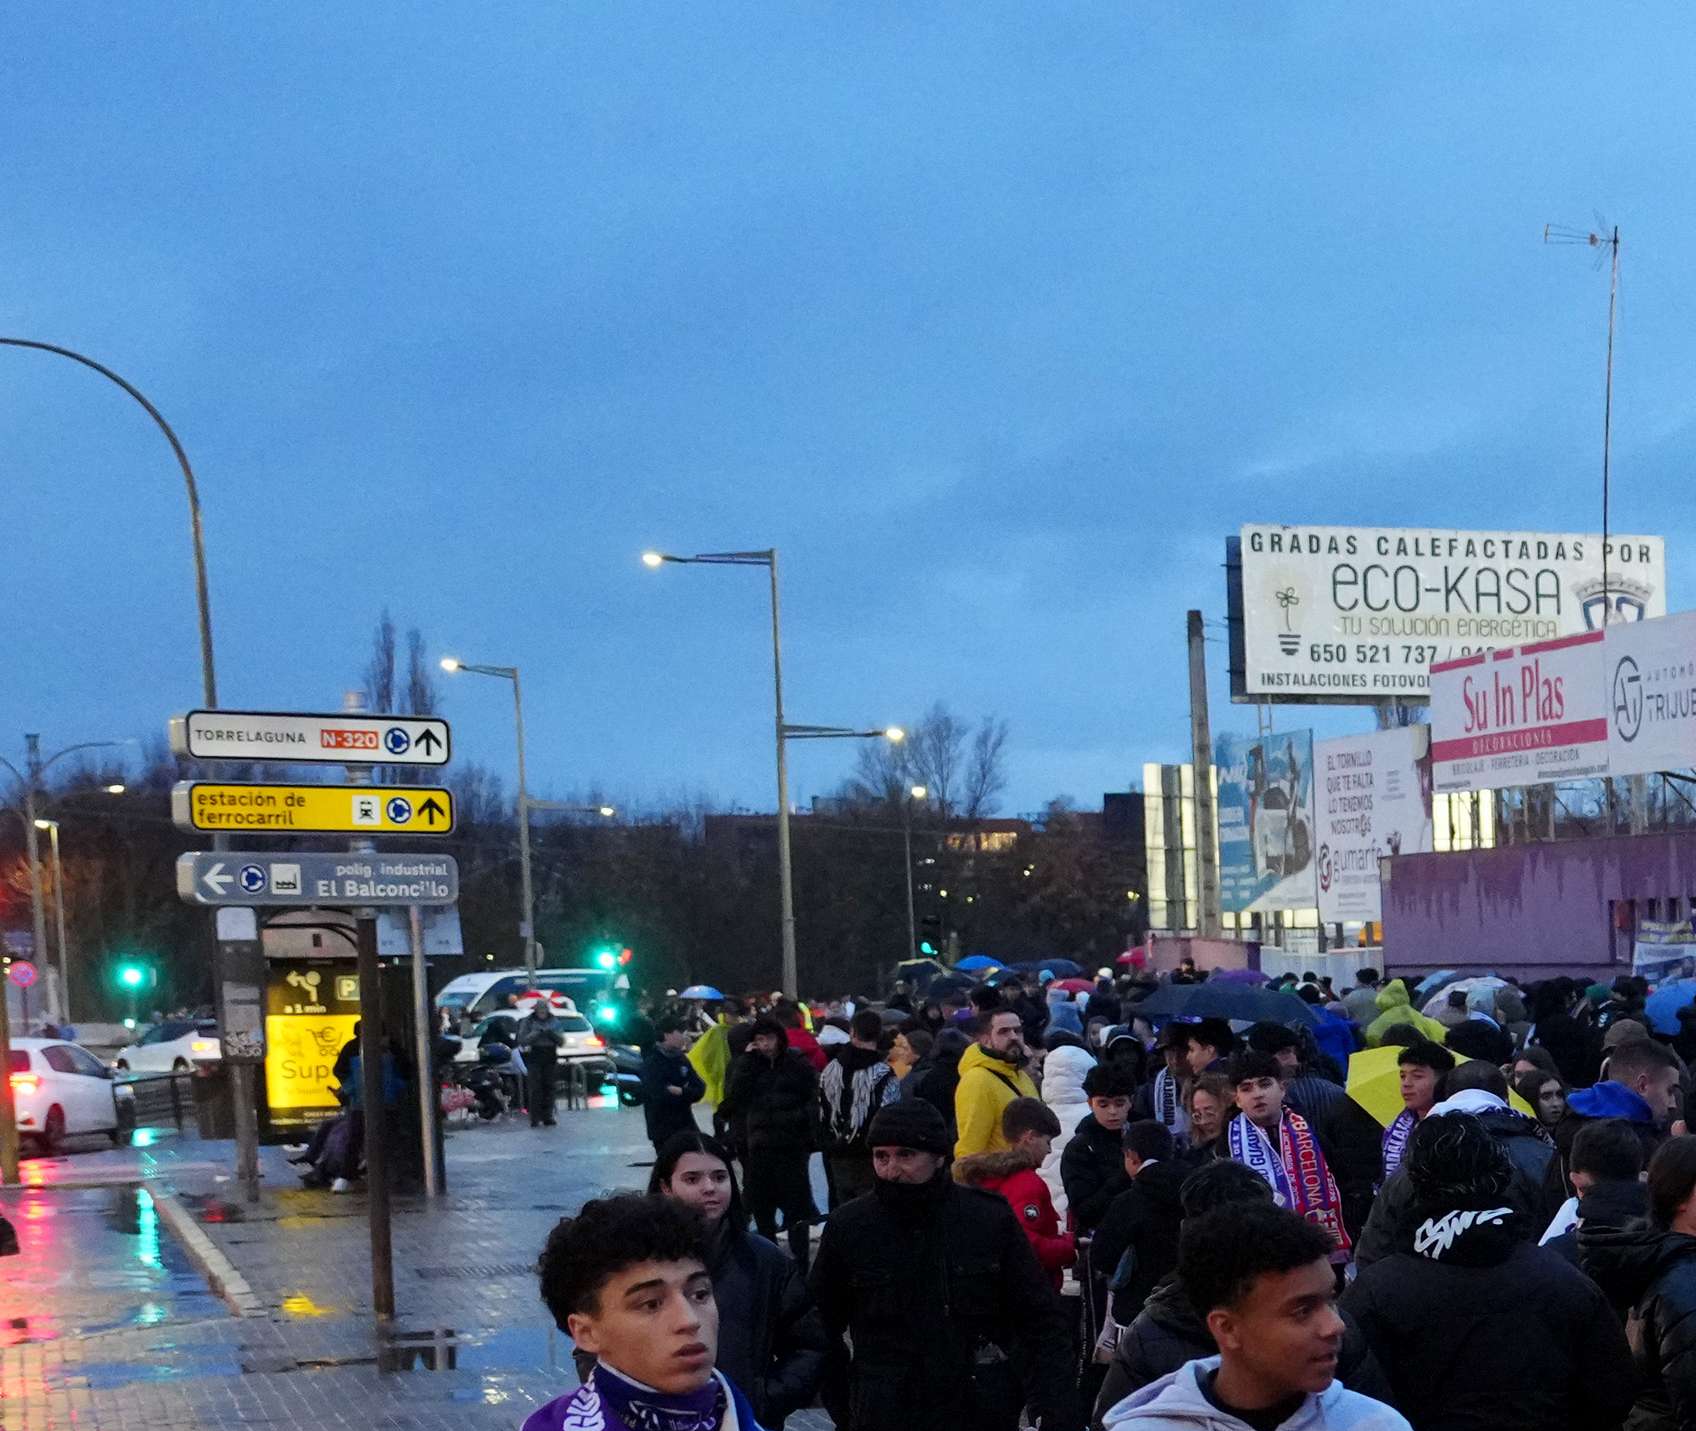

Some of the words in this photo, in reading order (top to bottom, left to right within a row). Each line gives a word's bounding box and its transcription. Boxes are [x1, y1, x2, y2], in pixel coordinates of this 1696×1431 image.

[1251, 532, 1358, 555] GRADAS
[1376, 536, 1585, 561] CALEFACTADAS
[1603, 541, 1652, 563] POR
[1340, 617, 1362, 636] TU
[1310, 644, 1346, 663] 650
[1357, 645, 1391, 663] 521
[1402, 645, 1437, 664] 737
[1262, 672, 1368, 688] INSTALACIONES
[1464, 675, 1486, 733] Su
[1495, 669, 1515, 728] In
[1521, 658, 1565, 723] Plas
[195, 729, 306, 744] TORRELAGUNA
[322, 731, 378, 748] N-320
[197, 790, 274, 808] estación
[284, 792, 306, 808] de
[197, 808, 294, 826] ferrocarril
[380, 862, 448, 877] industrial
[317, 881, 338, 897] El
[282, 1060, 330, 1083] Sup
